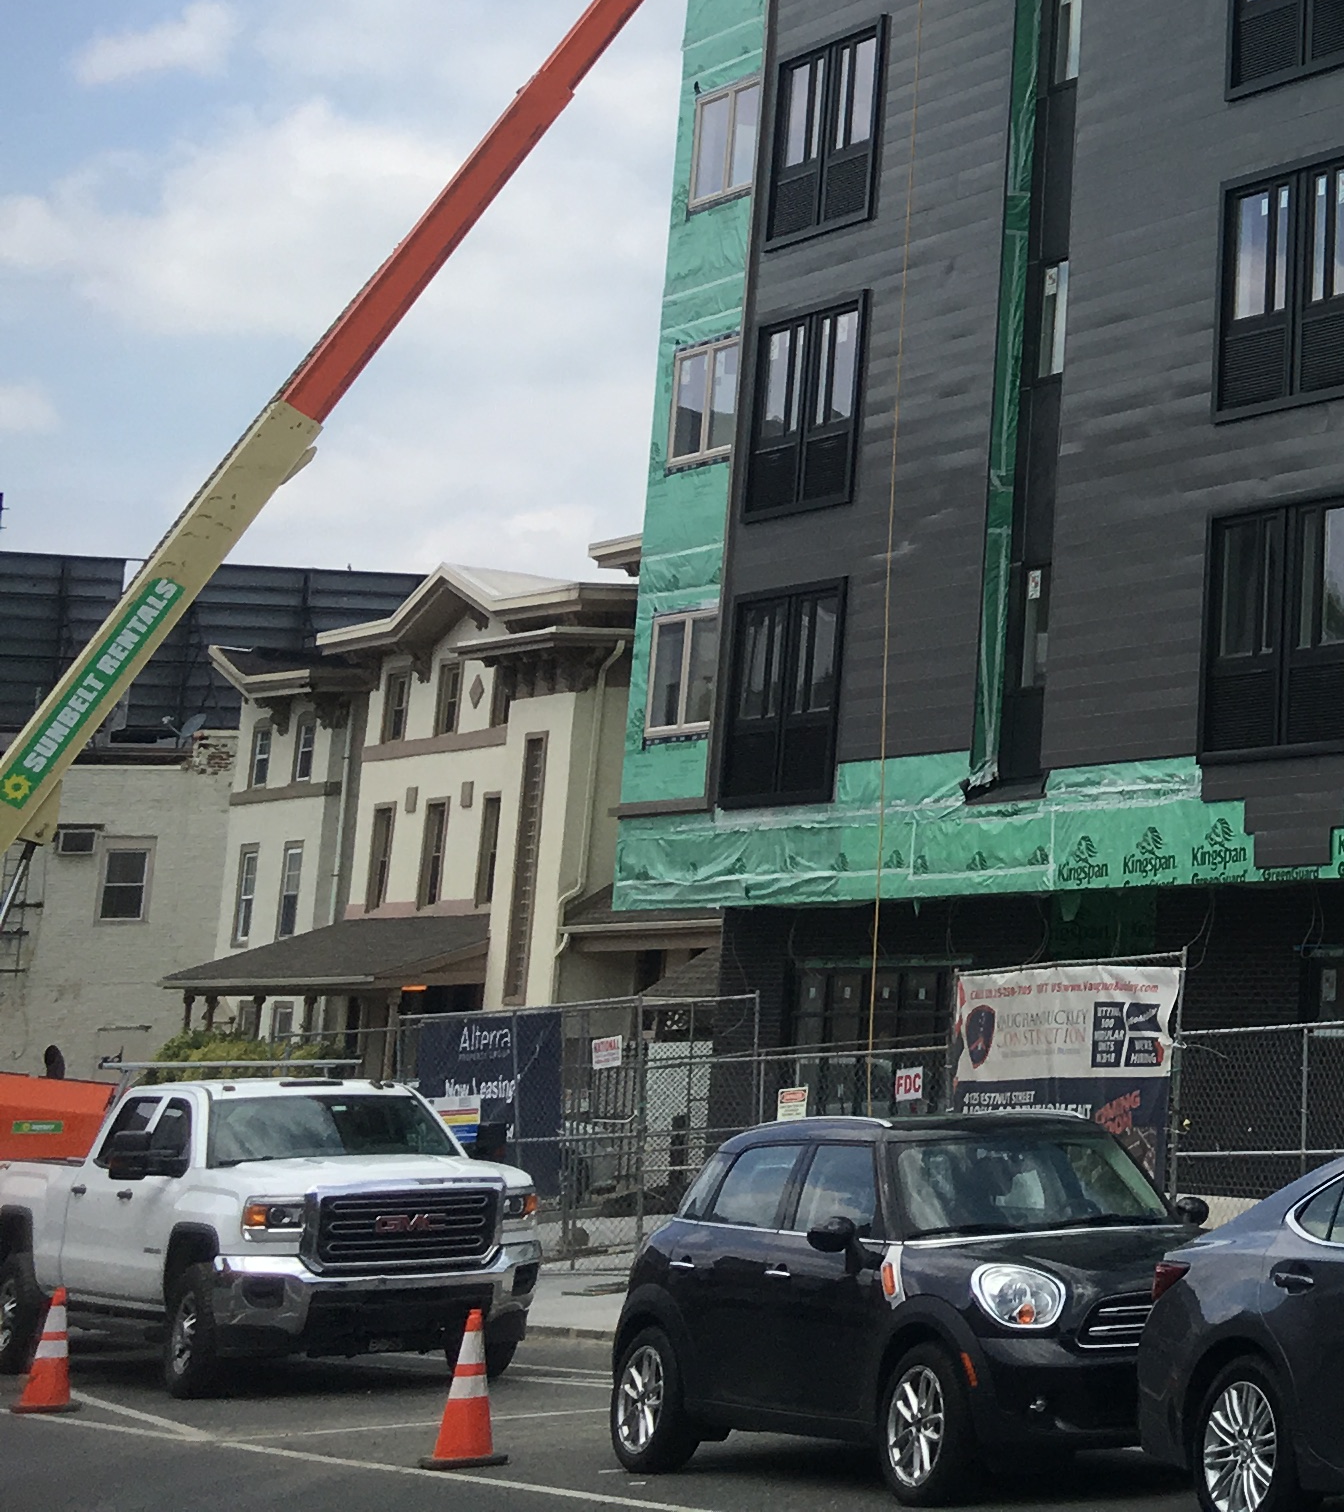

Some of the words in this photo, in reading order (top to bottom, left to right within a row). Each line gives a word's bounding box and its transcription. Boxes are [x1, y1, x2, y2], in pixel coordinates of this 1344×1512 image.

[23, 673, 105, 772] SUNBELT
[96, 579, 178, 676] RENTALS
[1123, 854, 1176, 878] Kingspan
[1191, 845, 1247, 871] Kingspan
[1057, 861, 1109, 884] Kingspan
[459, 1024, 511, 1052] Alterra
[445, 1079, 470, 1097] Now
[896, 1073, 921, 1095] FDC
[376, 1214, 446, 1232] GMC
